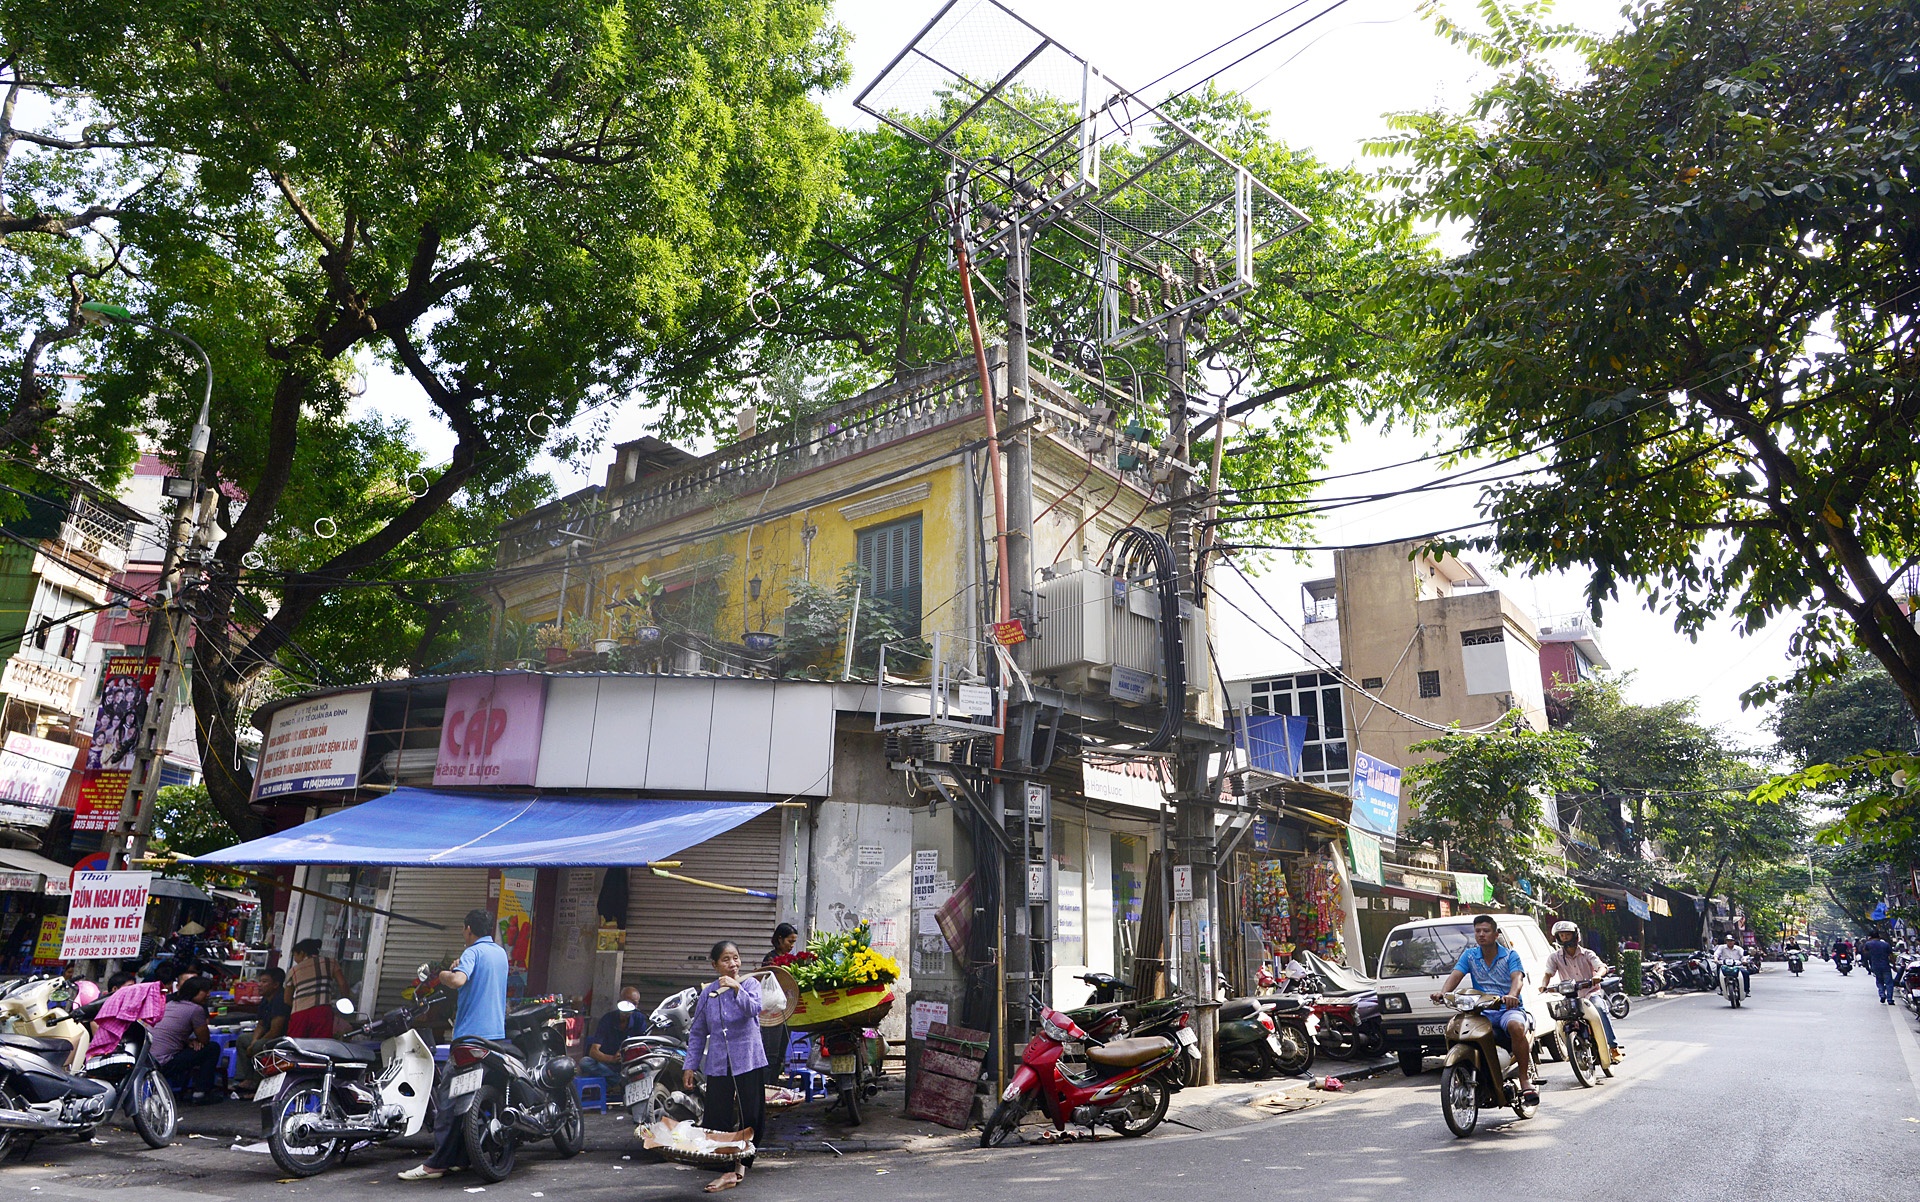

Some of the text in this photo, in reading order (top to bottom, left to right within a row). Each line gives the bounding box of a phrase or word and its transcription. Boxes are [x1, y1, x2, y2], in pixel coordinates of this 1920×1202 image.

[109, 664, 133, 675] XUÂN
[447, 690, 507, 758] CẤP
[72, 884, 148, 911] BÚN NGAN CHẶT
[70, 912, 142, 929] MĂNG TIẾT
[93, 934, 108, 945] PHỤC
[108, 934, 117, 945] VỤ
[117, 934, 126, 945] TẠI
[127, 933, 140, 942] NHÀ
[63, 946, 137, 957] ĐT: 0932 313 939
